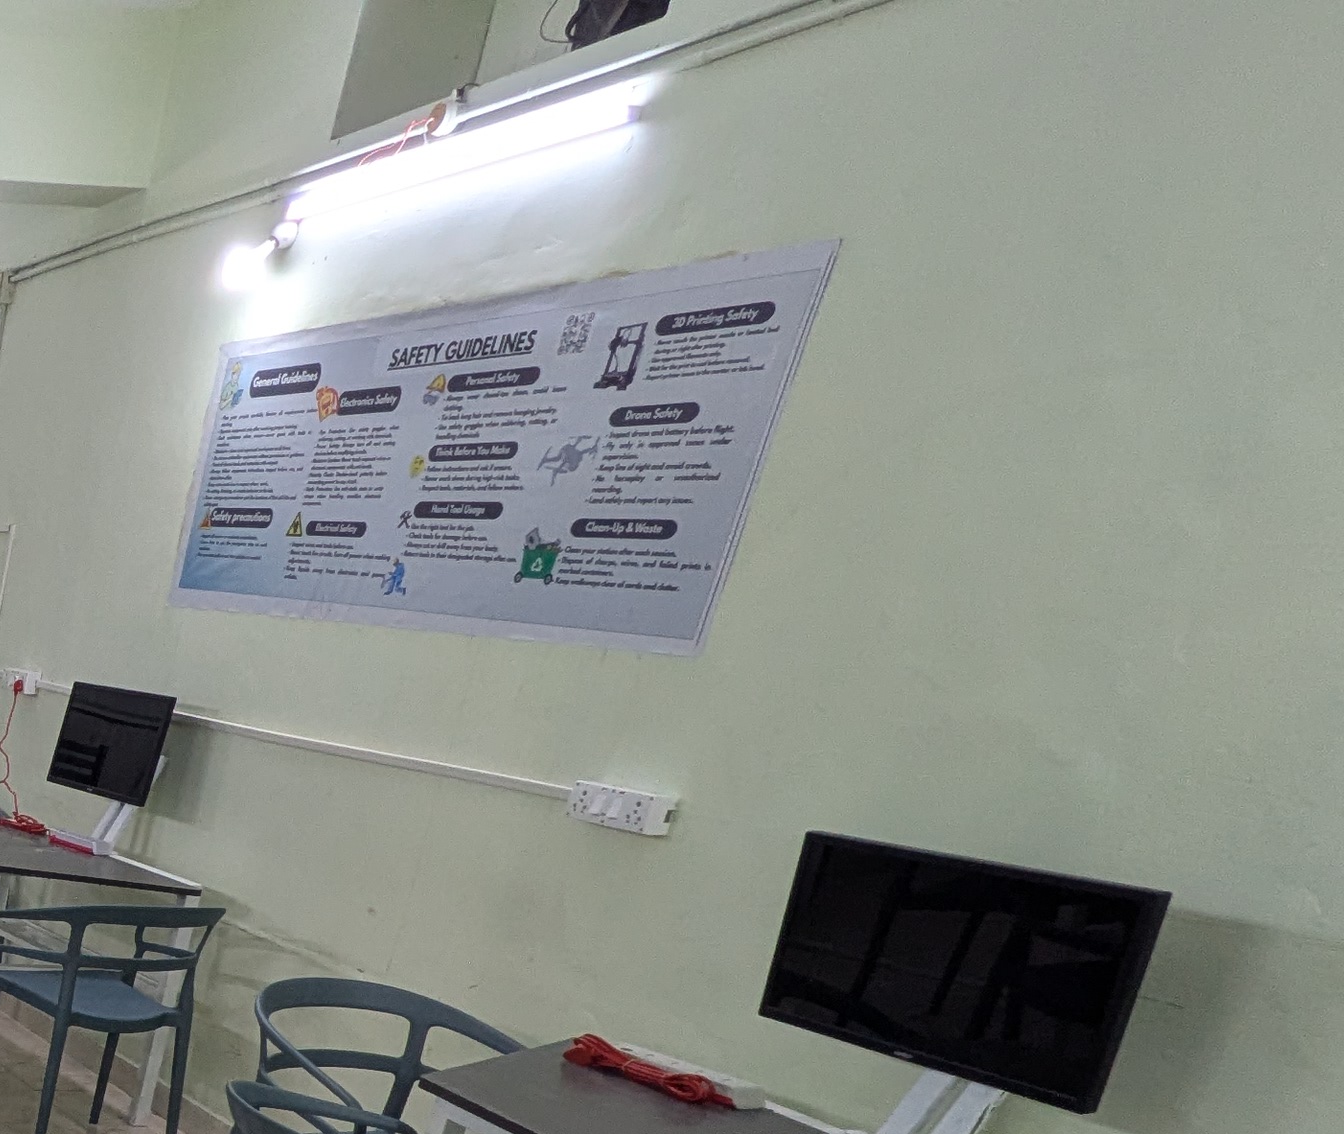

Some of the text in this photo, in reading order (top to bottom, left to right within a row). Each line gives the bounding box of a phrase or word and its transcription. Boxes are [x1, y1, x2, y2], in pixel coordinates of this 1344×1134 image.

[672, 307, 759, 328] 3D Printing Safety
[389, 330, 538, 367] SAFETY GUIDELINES
[253, 370, 318, 388] General Guidelines
[466, 369, 520, 386] Personal Safety
[339, 393, 398, 408] Electronics Safety
[625, 407, 683, 420] Drone Safety
[435, 445, 510, 457] Think Before You Make
[431, 504, 486, 516] Hand Tool Usage
[211, 511, 271, 524] Safety precautions
[315, 523, 357, 534] Electrical Safety
[585, 521, 663, 534] Clean-Up & Waste
